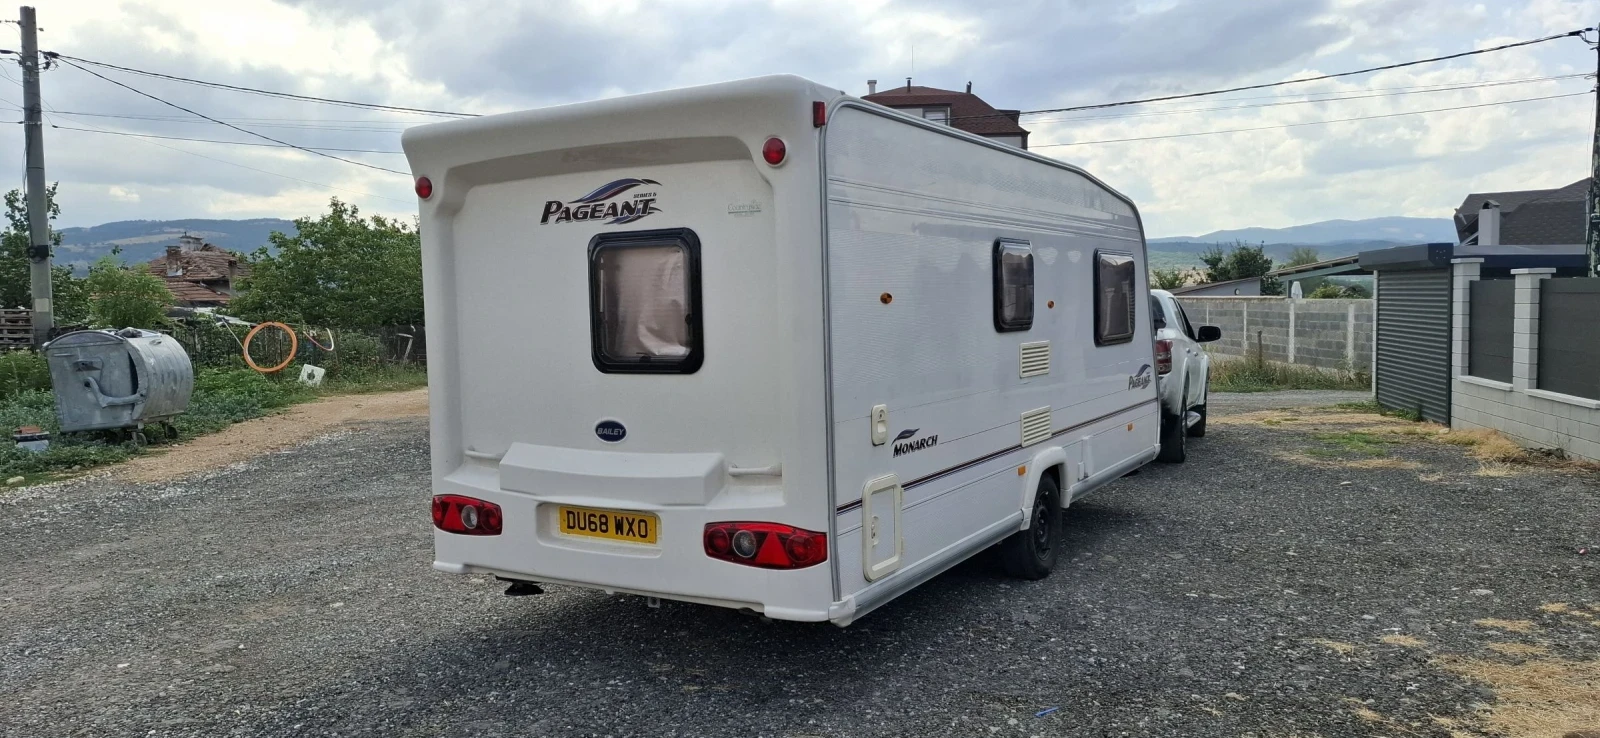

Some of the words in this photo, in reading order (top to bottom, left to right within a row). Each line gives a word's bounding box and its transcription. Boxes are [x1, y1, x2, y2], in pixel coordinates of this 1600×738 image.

[540, 199, 656, 224] PAGEANT
[597, 428, 625, 436] BAILEY
[893, 435, 938, 458] MONARCH
[566, 510, 609, 533] DU68
[614, 515, 649, 538] WXO
